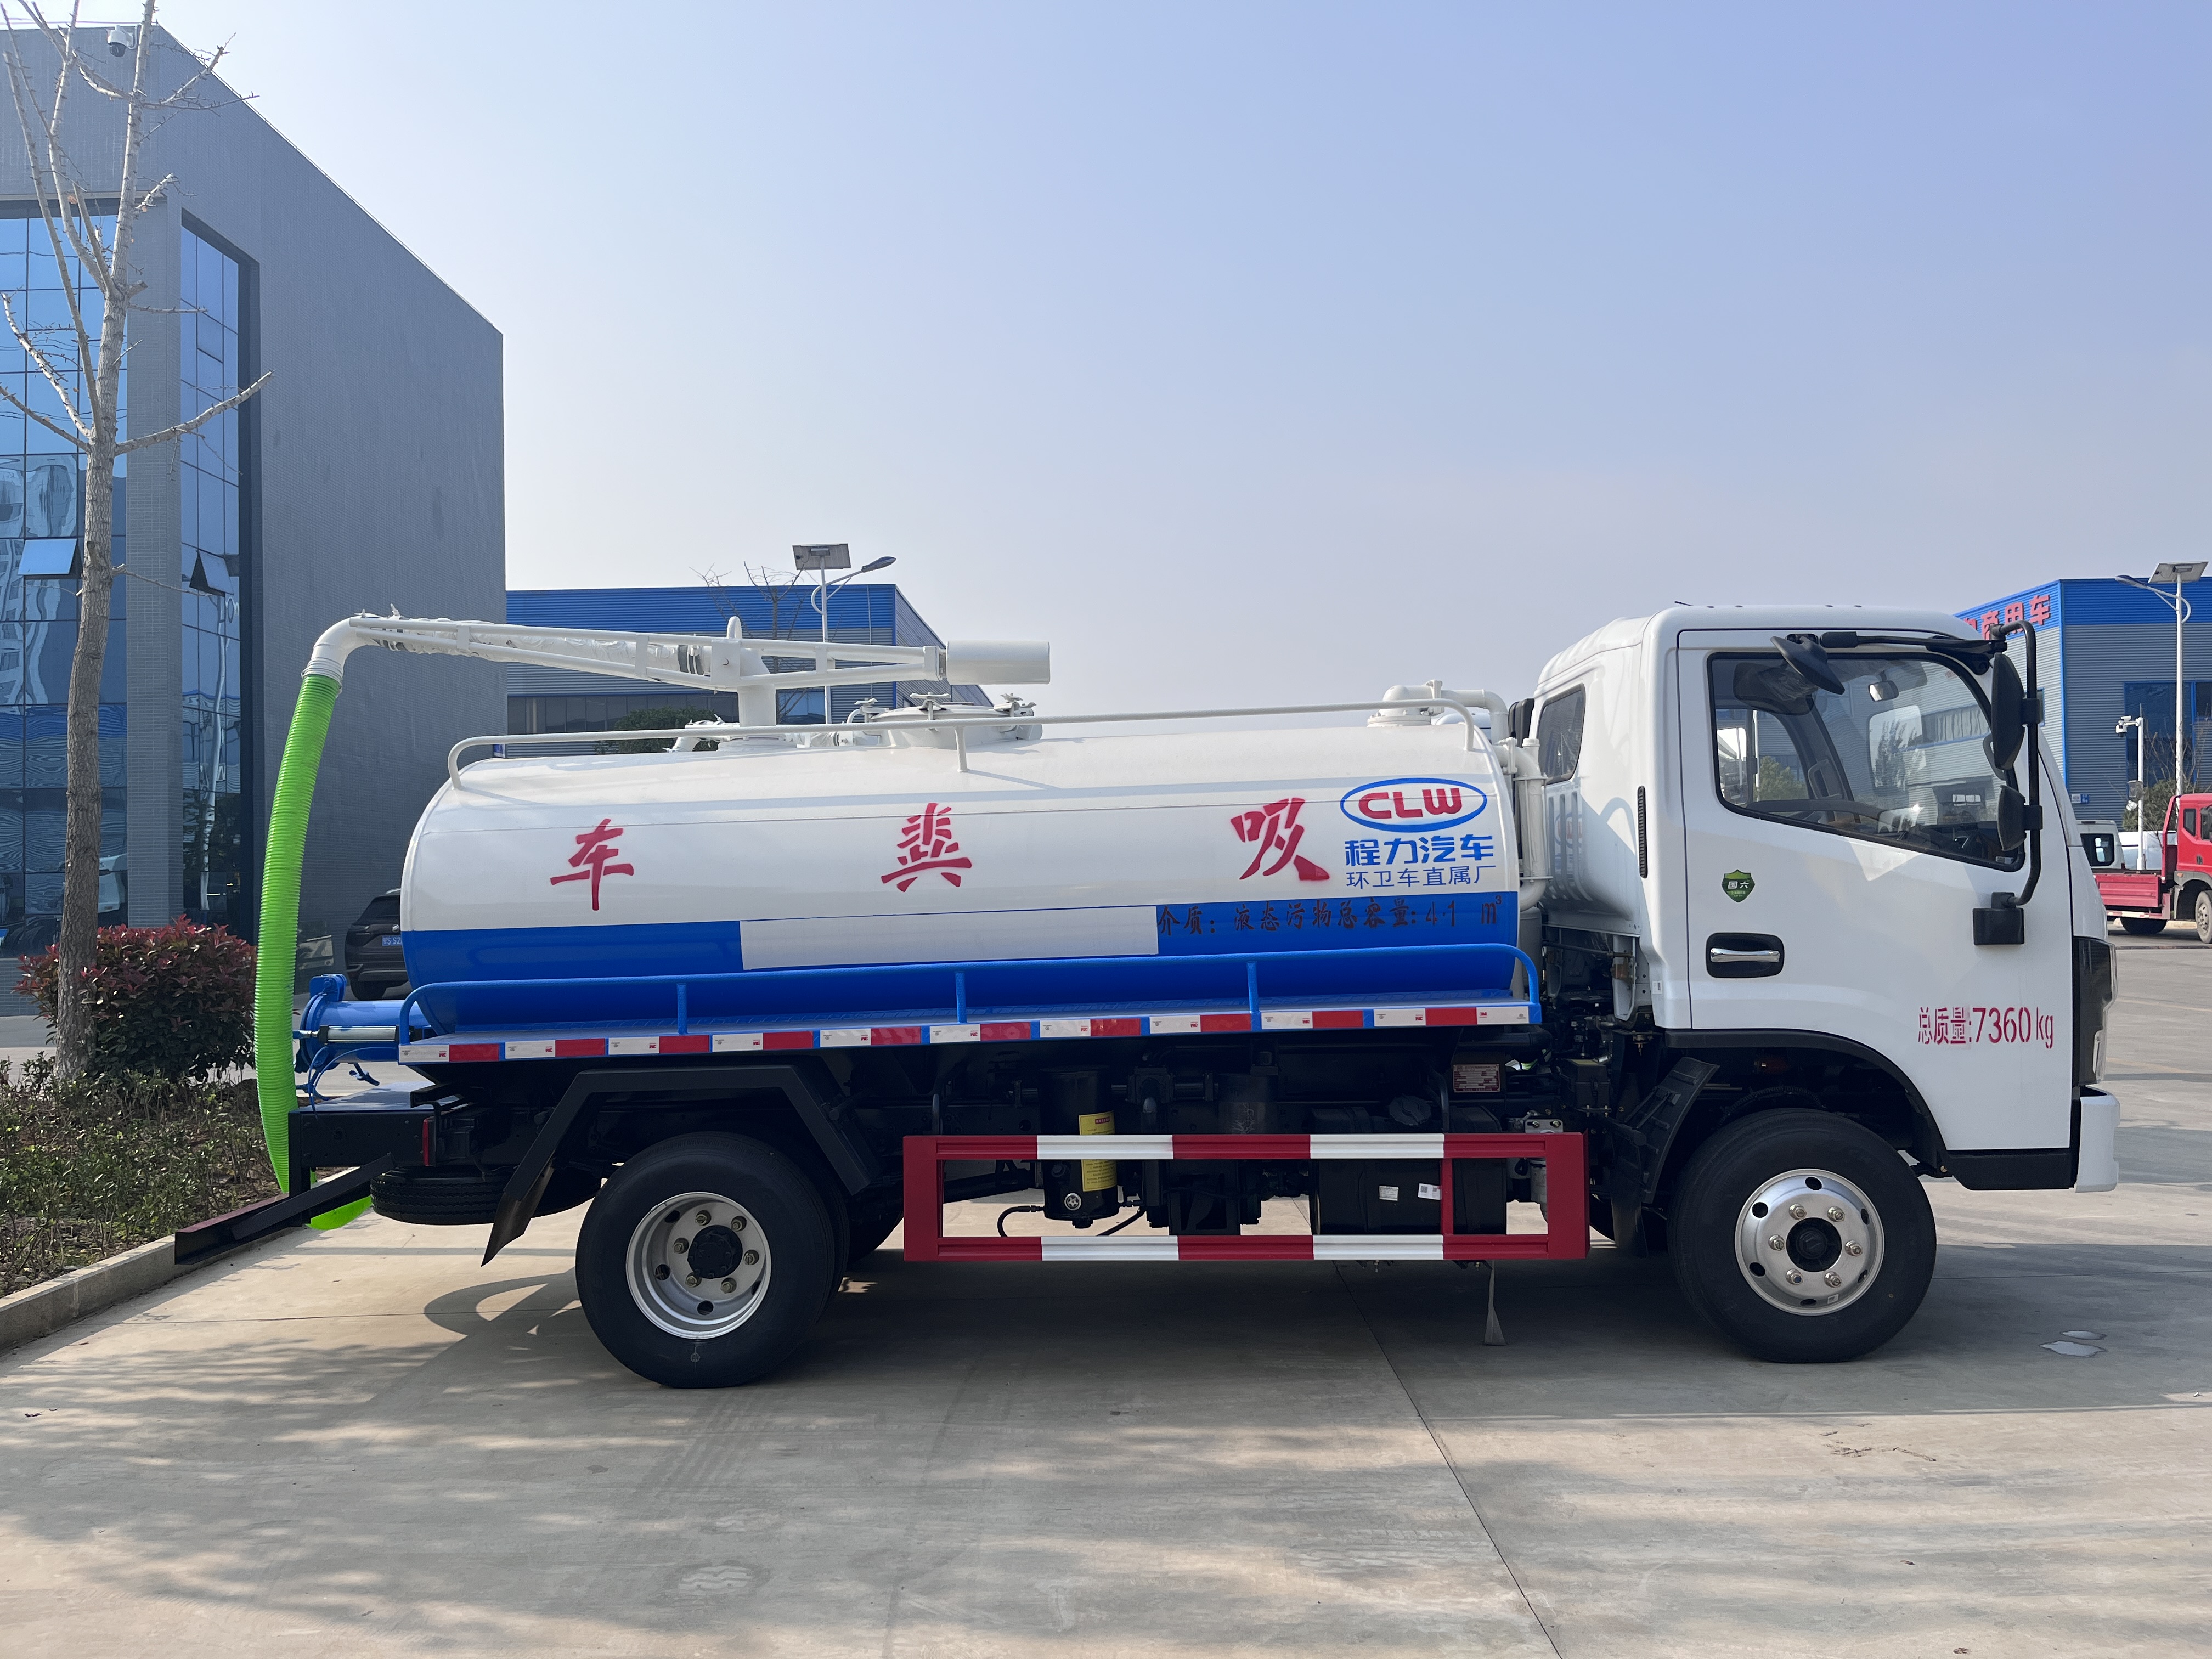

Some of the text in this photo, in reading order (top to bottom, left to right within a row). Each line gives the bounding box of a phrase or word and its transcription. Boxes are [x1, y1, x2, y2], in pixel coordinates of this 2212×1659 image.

[1358, 787, 1463, 819] CLW
[551, 818, 634, 911] 车
[1230, 797, 1330, 882] 吸
[1345, 834, 1494, 867] 程力汽车
[1346, 865, 1496, 889] 环卫车直属厂
